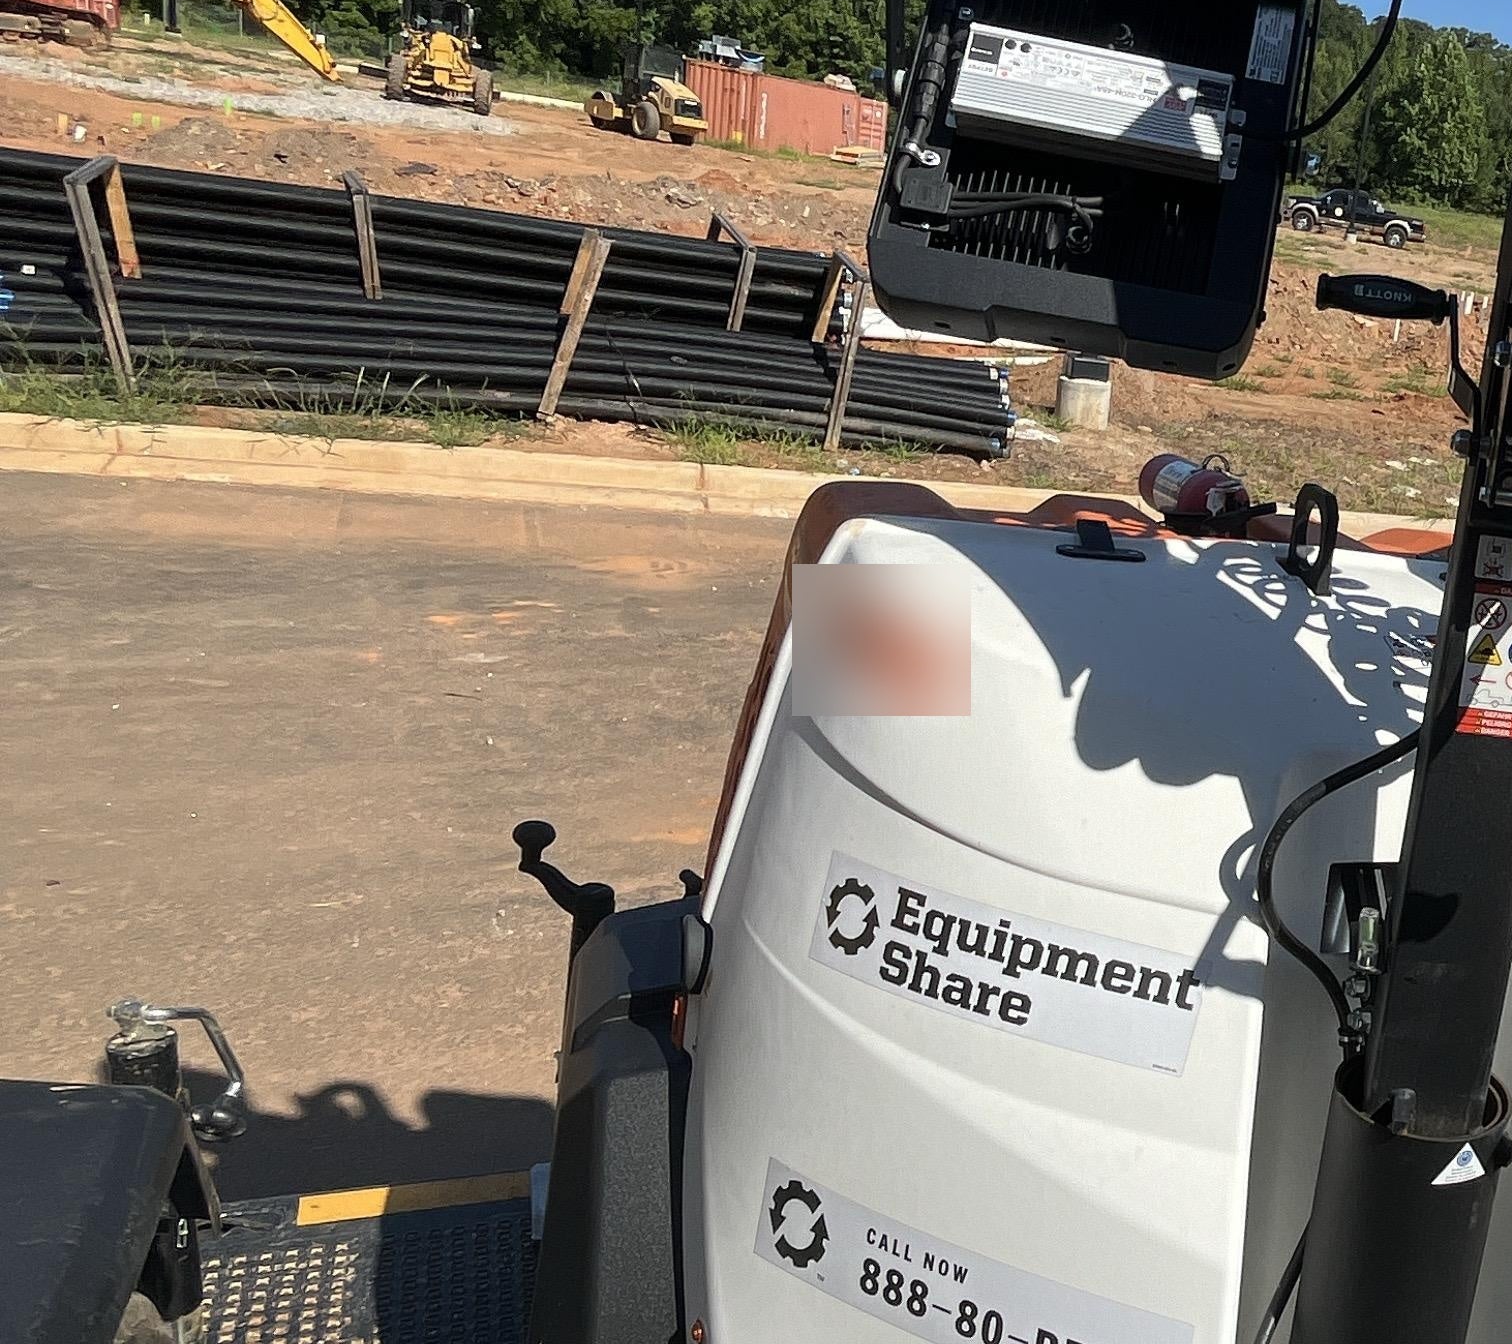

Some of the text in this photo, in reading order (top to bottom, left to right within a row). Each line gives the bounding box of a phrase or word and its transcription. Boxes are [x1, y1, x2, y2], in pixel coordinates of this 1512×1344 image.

[1365, 288, 1412, 302] KNOTT
[879, 940, 1033, 1026] Share
[891, 886, 1201, 1011] Equipment
[866, 1227, 969, 1285] CALL NOW
